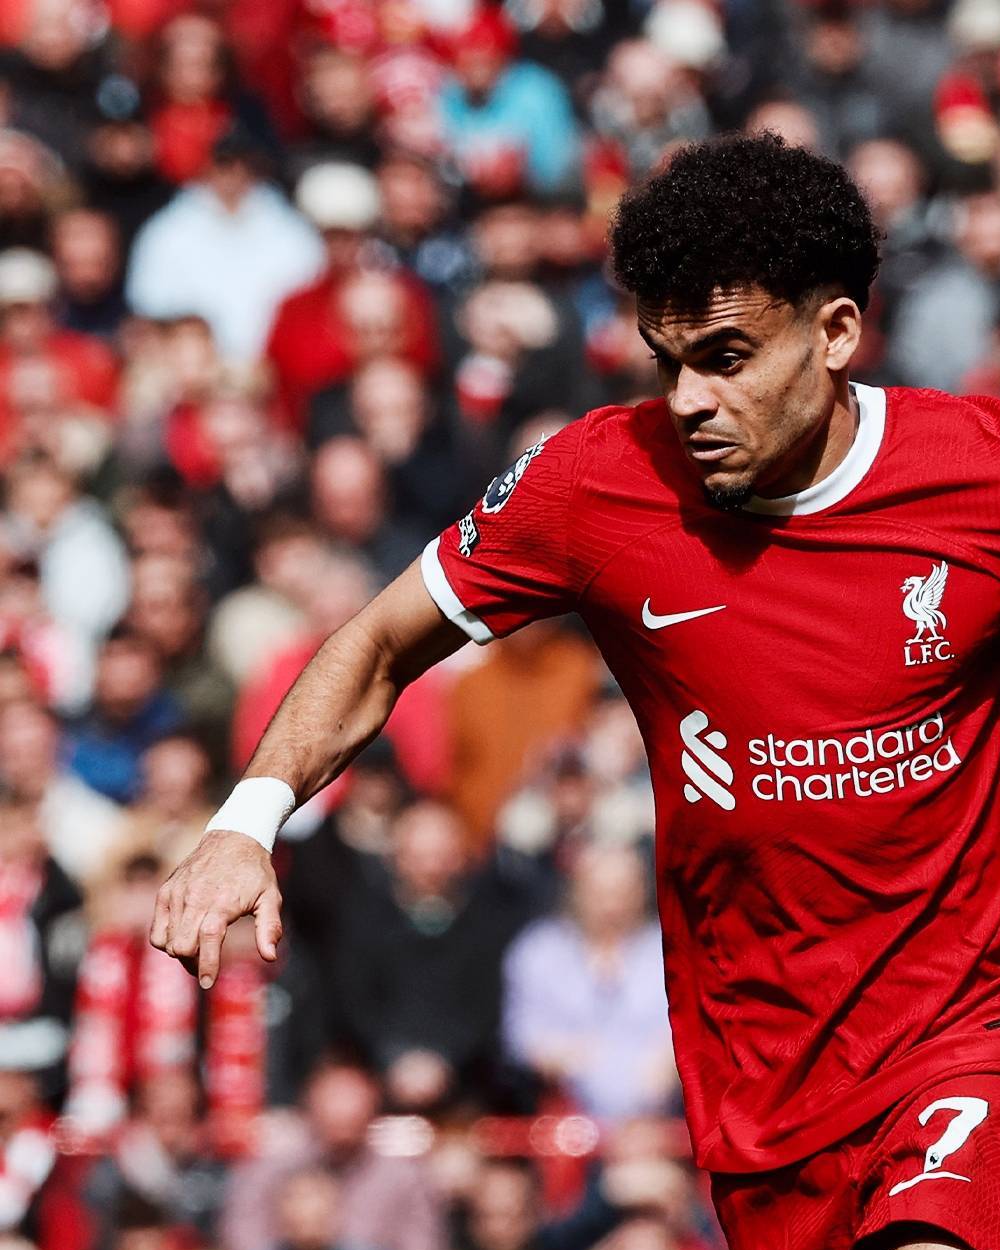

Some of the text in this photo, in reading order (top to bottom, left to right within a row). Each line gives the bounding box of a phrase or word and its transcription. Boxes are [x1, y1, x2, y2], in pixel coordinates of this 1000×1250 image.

[904, 641, 955, 666] L.F.C.
[748, 712, 945, 768] standard
[752, 736, 962, 801] chartered
[918, 1096, 989, 1174] 7
